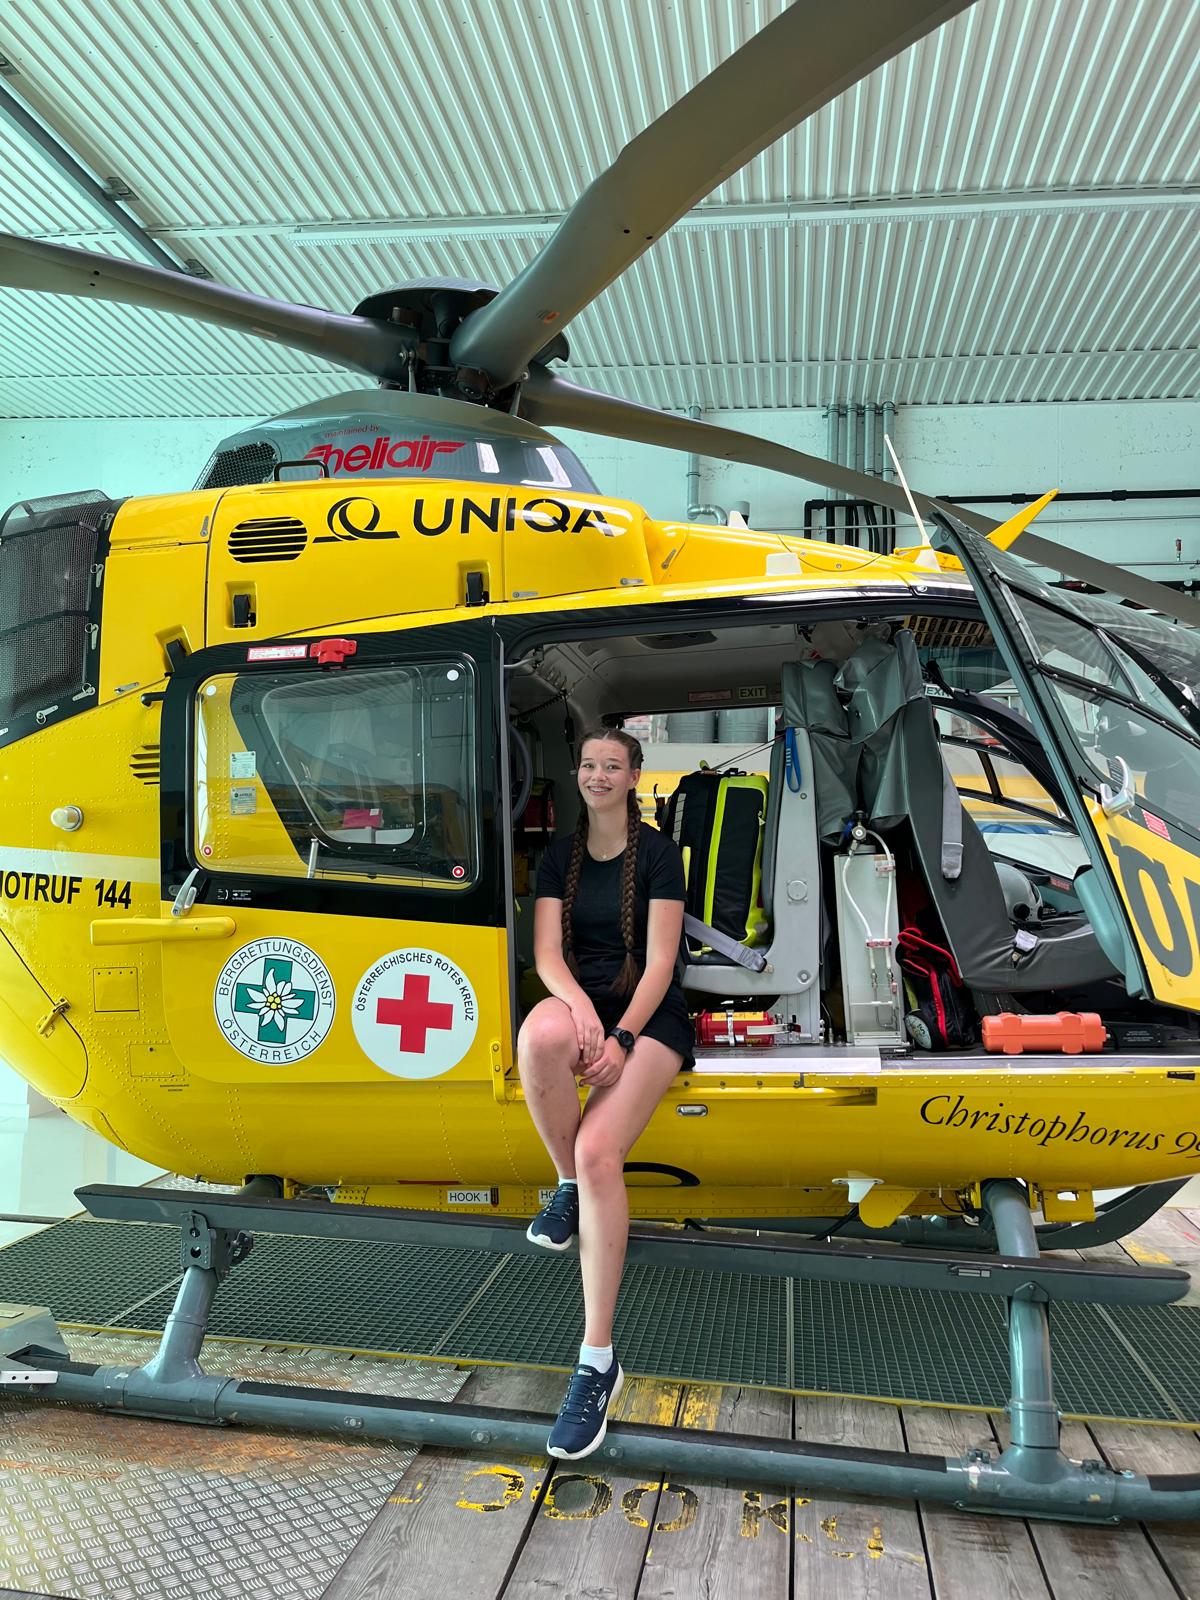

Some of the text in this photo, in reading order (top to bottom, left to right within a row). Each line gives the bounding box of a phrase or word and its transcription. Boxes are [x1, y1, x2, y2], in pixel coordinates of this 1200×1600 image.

[370, 424, 380, 433] by
[304, 435, 465, 478] heliair
[413, 497, 615, 538] UNIQA
[740, 687, 765, 697] EXIT
[95, 878, 131, 909] 144
[219, 941, 332, 1008] BERGRETTUNGSDIENST
[355, 952, 474, 1021] ÖSTERREICHISCHES ROTES KREUZ
[222, 1018, 322, 1060] ÖSTERREICH
[920, 1095, 1165, 1151] Christophorus
[449, 1192, 489, 1203] HOOK 1
